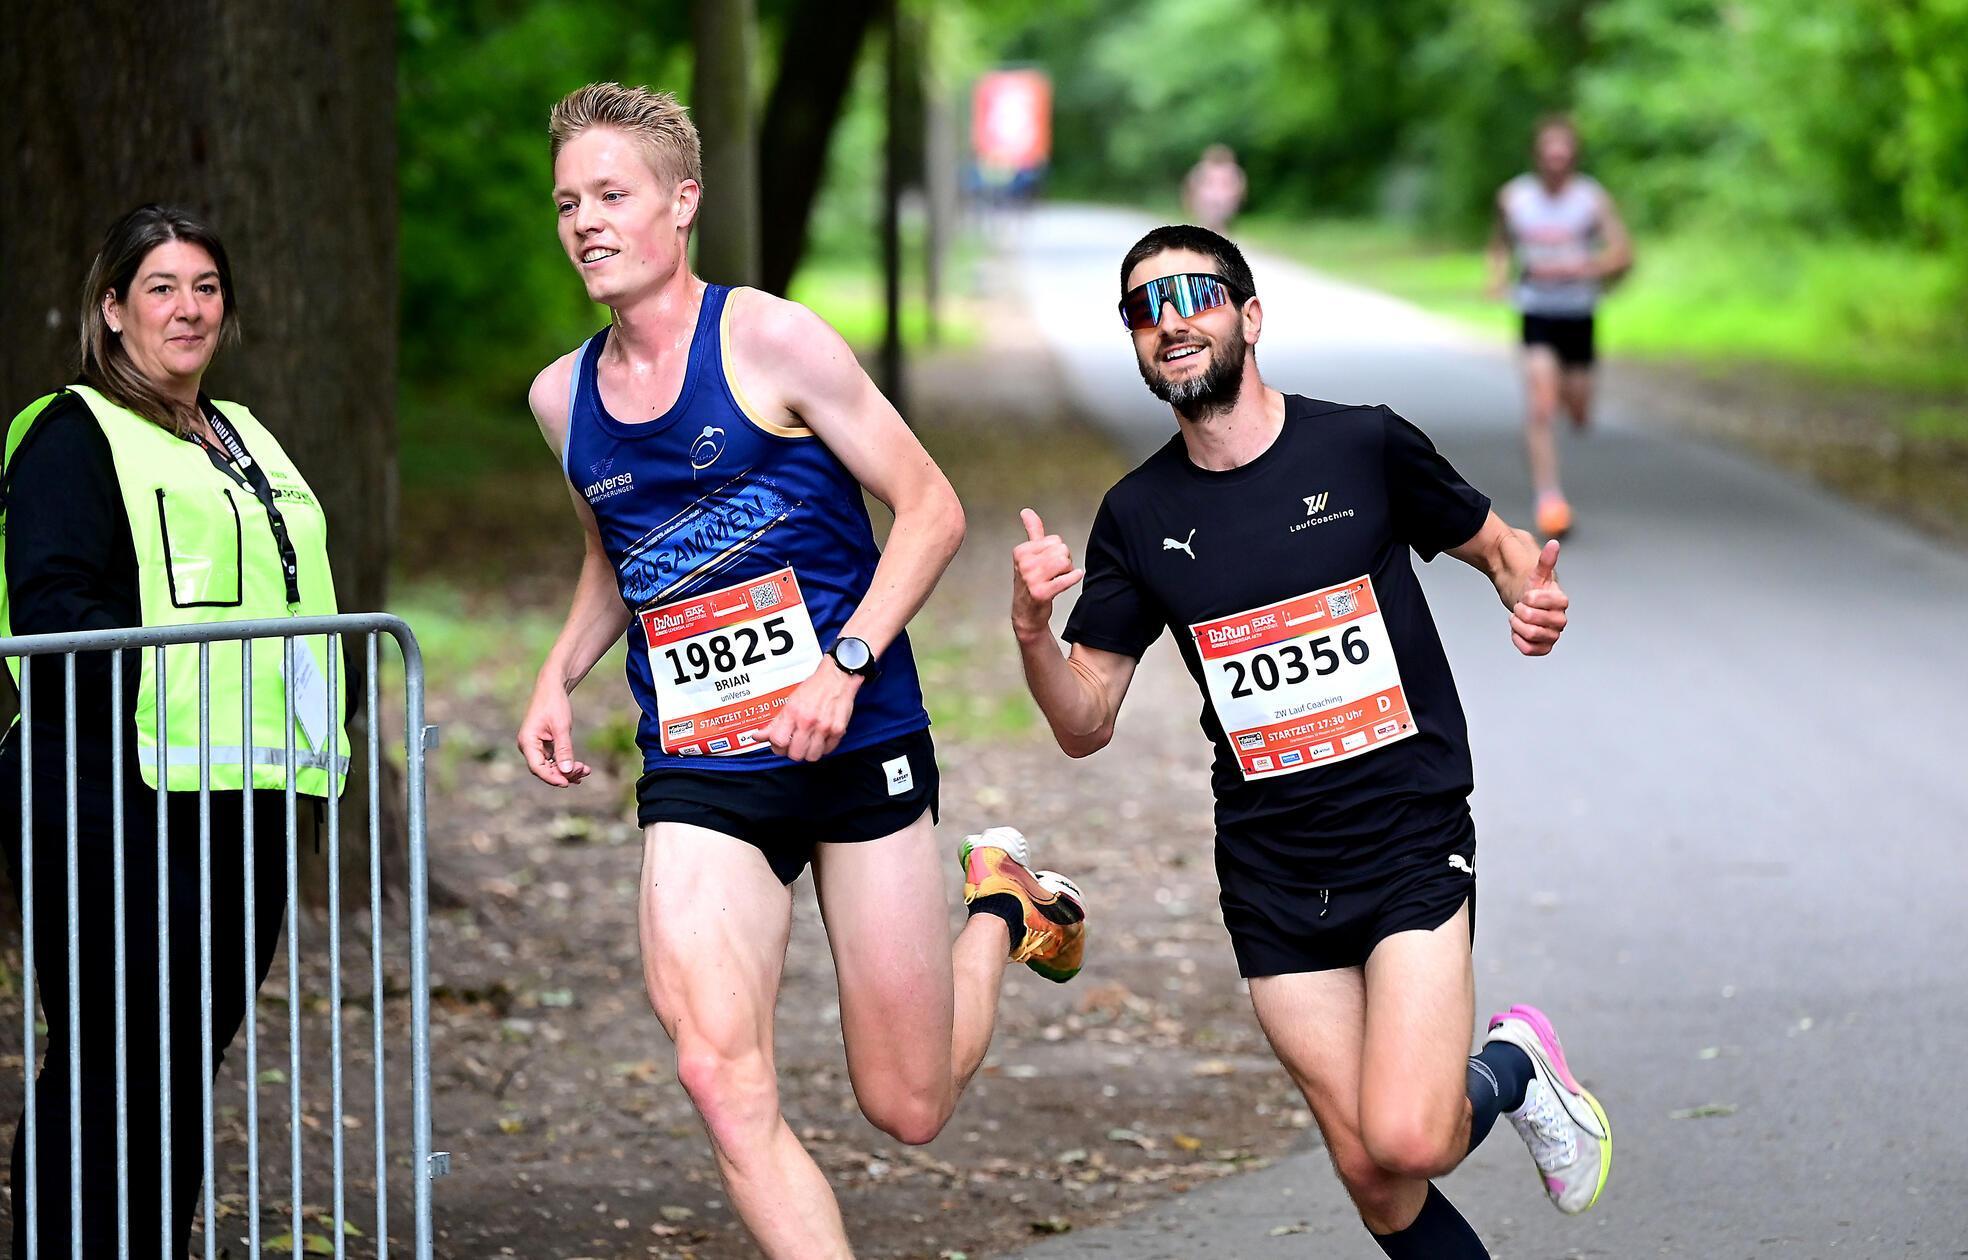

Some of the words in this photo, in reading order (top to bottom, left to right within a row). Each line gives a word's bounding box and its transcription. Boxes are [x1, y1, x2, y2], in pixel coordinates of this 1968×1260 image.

[584, 470, 633, 498] uniVersa
[589, 485, 635, 505] ERSICHERUNGEN
[1290, 509, 1354, 532] LaufCoaching
[1208, 623, 1251, 643] B2Run
[665, 616, 794, 686] 19825
[1223, 625, 1370, 699] 20356
[714, 673, 751, 692] BRIAN
[720, 689, 751, 703] uniVersa
[1274, 709, 1288, 719] ZW
[1288, 704, 1305, 717] Lauf
[1306, 694, 1344, 712] Coaching
[1376, 695, 1392, 713] D
[699, 710, 742, 729] STARTZEIT
[744, 702, 770, 718] 17:30
[1268, 723, 1316, 743] STARTZEIT
[1317, 714, 1345, 731] 17:30
[1345, 709, 1364, 722] Uhr
